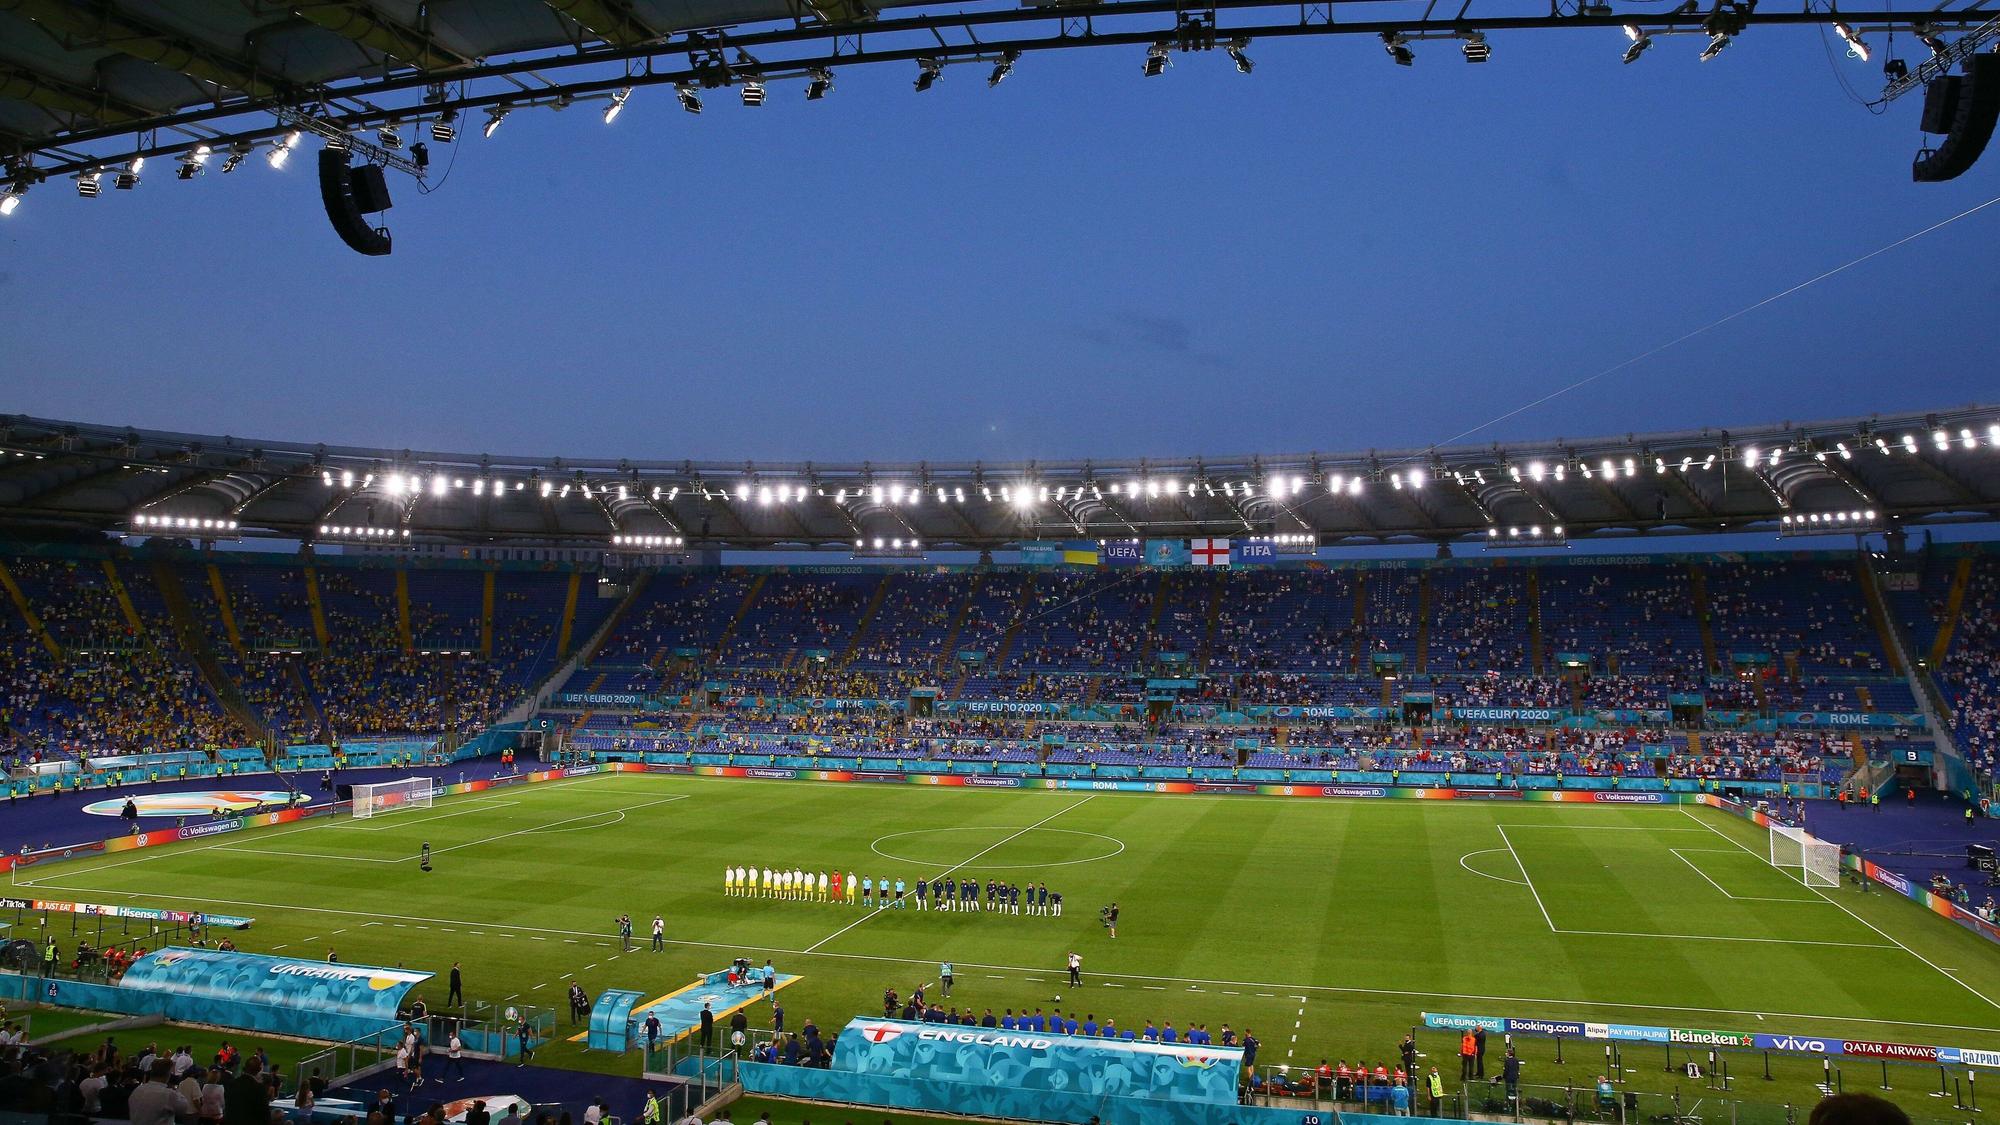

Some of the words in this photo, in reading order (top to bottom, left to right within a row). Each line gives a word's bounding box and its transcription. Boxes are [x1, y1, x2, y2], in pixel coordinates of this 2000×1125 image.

[1108, 547, 1137, 557] UEFA
[1243, 546, 1271, 556] FIFA
[589, 695, 613, 703] EURO
[614, 695, 635, 703] 2020
[1017, 702, 1042, 713] 2020
[1458, 708, 1488, 719] UEFA
[1521, 710, 1550, 720] 2020
[1830, 714, 1870, 724] ROME
[541, 720, 548, 728] C
[1908, 751, 1917, 760] B
[1093, 781, 1118, 790] ROMA
[1333, 788, 1371, 796] Volkswagen
[1605, 793, 1647, 802] Volkswagen
[190, 823, 230, 835] Volkswagen
[6, 900, 26, 909] TikTok
[44, 901, 59, 910] JUST
[60, 903, 72, 911] EAT
[85, 905, 107, 915] FedEx
[119, 907, 158, 919] Hisense
[171, 912, 184, 921] The
[270, 964, 360, 981] UKRAINE
[1432, 1017, 1453, 1025] UEFA
[1455, 1019, 1476, 1027] EURO
[1477, 1020, 1497, 1028] 2020
[1510, 1020, 1580, 1034] Booking.com
[1586, 1026, 1607, 1035] Alipay
[1624, 1029, 1642, 1037] WITH
[1643, 1030, 1667, 1039] ALIPAY
[918, 1029, 1052, 1049] ENGLAND
[1669, 1029, 1738, 1045] Heineken
[1772, 1036, 1825, 1051] vivo
[1843, 1042, 1883, 1054] QATAR
[1886, 1045, 1937, 1058] AIRWAYS
[1962, 1052, 2000, 1065] GAZPRO
[1305, 1116, 1318, 1125] 10
